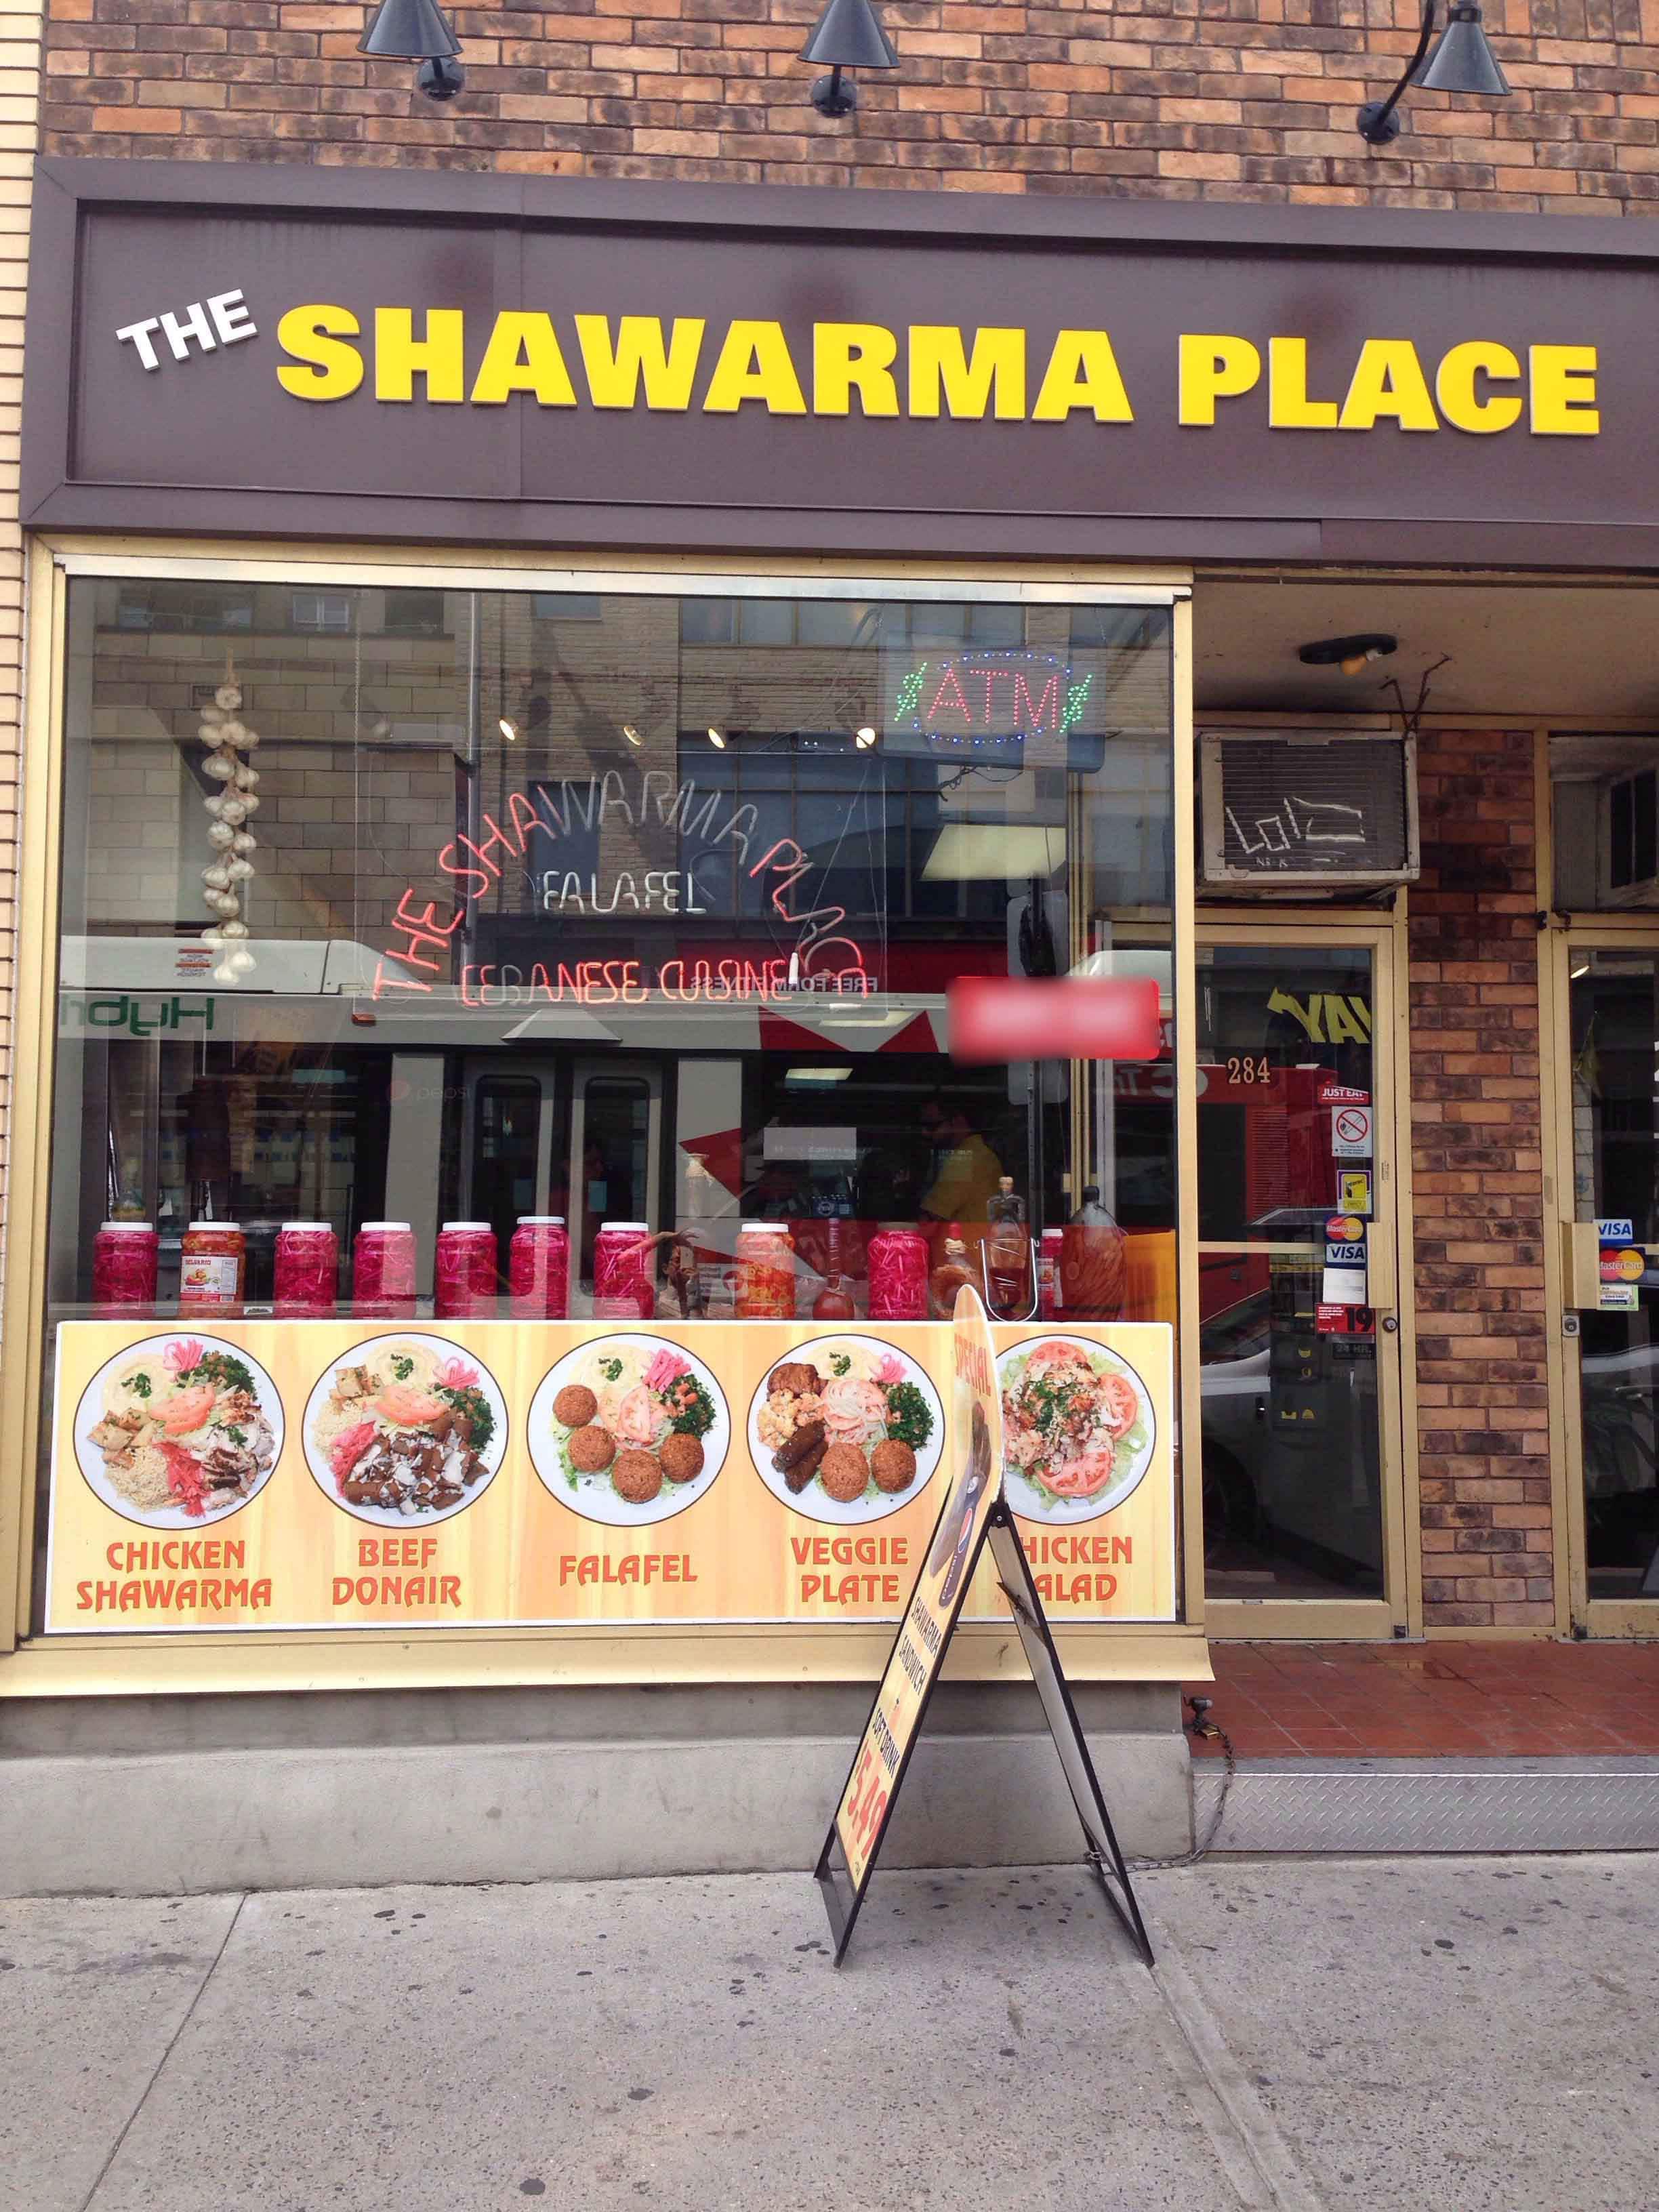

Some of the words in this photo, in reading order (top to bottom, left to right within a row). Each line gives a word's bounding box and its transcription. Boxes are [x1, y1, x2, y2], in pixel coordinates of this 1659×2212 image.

[115, 289, 258, 372] THE
[276, 304, 1134, 424] SHAWARMA
[1178, 334, 1599, 436] PLACE
[926, 668, 1058, 729] ATM
[373, 888, 466, 1001] THE
[438, 770, 759, 899] SHAWARMA
[542, 871, 706, 914] FALAFEL
[462, 960, 649, 1006] LEBANESE
[1227, 1057, 1271, 1084] 284
[1322, 1088, 1345, 1097] JUST
[1599, 1223, 1631, 1235] VISA
[1329, 1246, 1364, 1259] VISA
[1599, 1261, 1643, 1270] asterCard
[1346, 1307, 1374, 1332] 19
[954, 1333, 991, 1397] SPECIAL
[106, 1541, 245, 1572] CHICKEN
[359, 1538, 437, 1570] BEEF
[790, 1537, 908, 1565] VEGGIE
[1019, 1536, 1132, 1564] HICKEN
[560, 1554, 697, 1586] FALAFEL
[76, 1578, 272, 1612] SHAWARMA
[332, 1576, 462, 1608] DONAIR
[802, 1574, 900, 1603] PLATE
[1035, 1574, 1118, 1604] ALAD
[912, 1596, 942, 1658] SHAWARMA
[899, 1635, 927, 1696] SANDWICH
[872, 1708, 886, 1746] SOFT
[880, 1729, 901, 1779] DRINK
